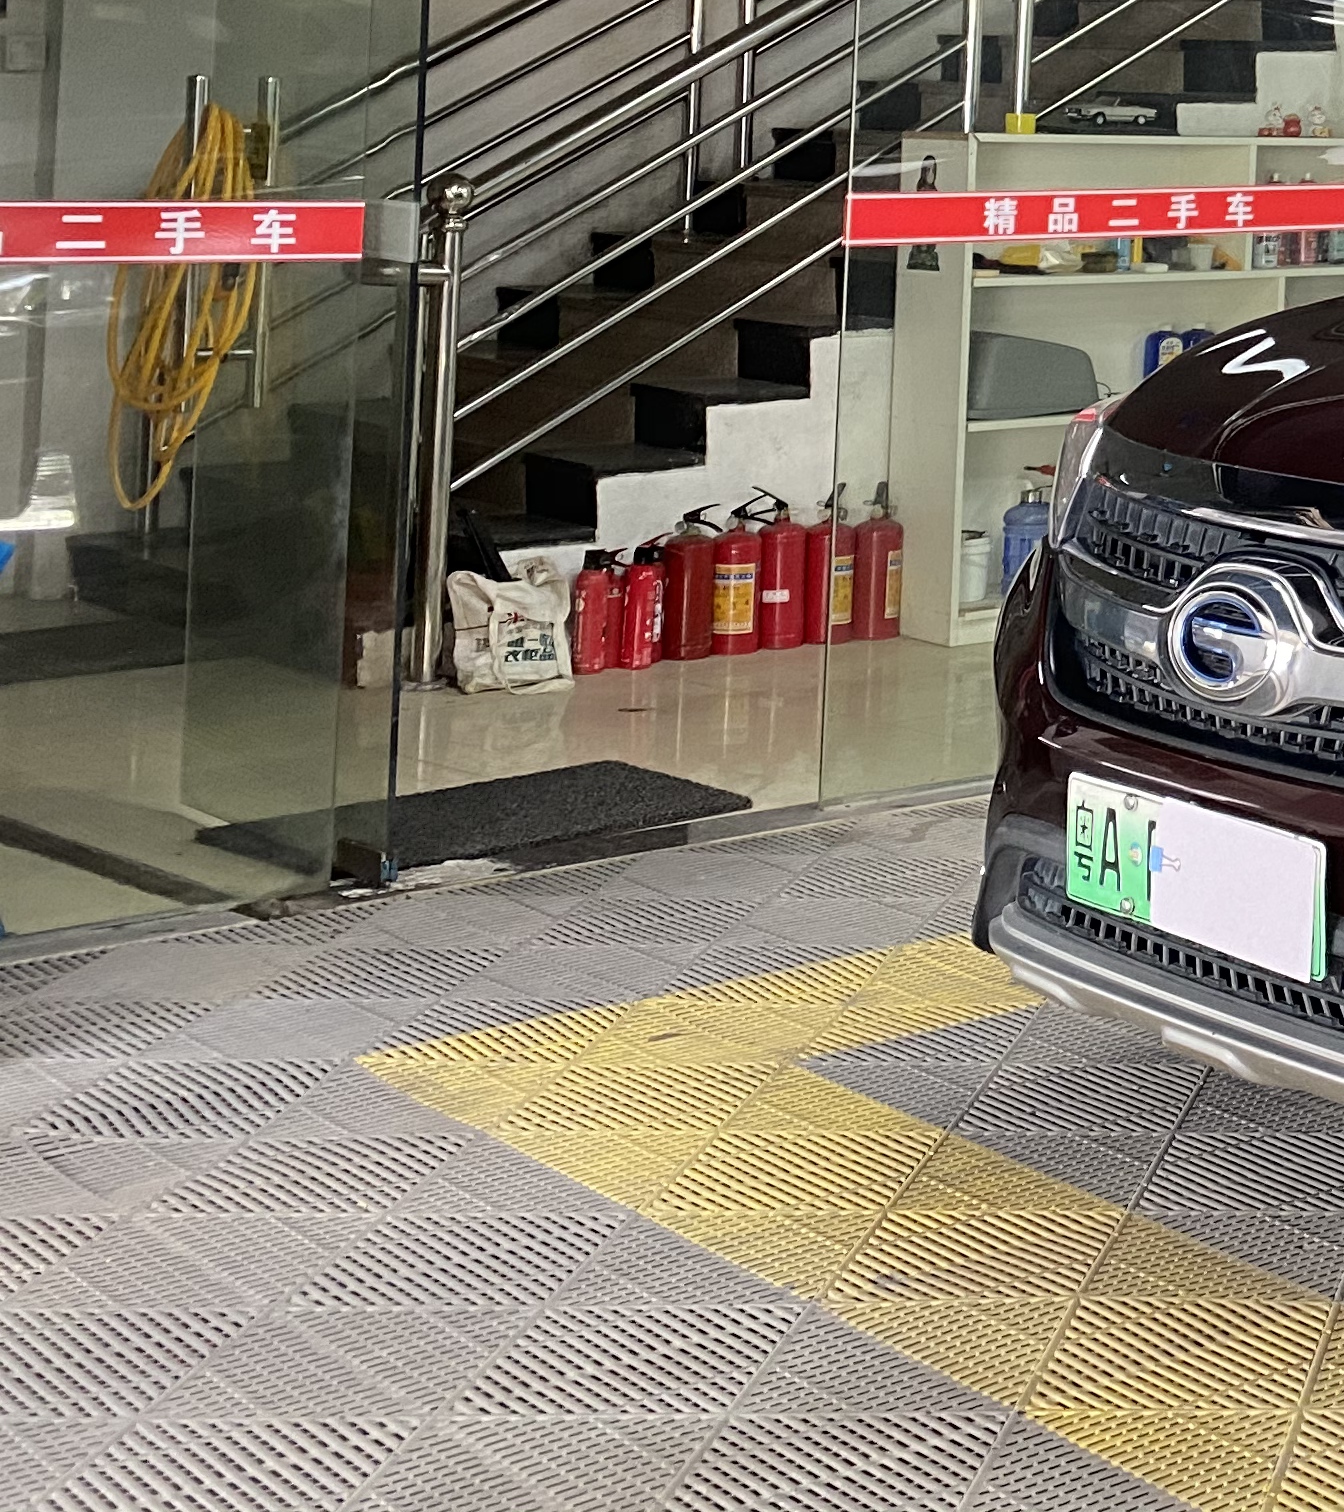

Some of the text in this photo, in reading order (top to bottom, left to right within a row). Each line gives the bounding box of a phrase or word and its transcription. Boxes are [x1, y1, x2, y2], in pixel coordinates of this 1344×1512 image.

[0, 209, 297, 255] 二手车
[983, 192, 1254, 235] 精品二手车
[1074, 799, 1157, 901] 粤A
